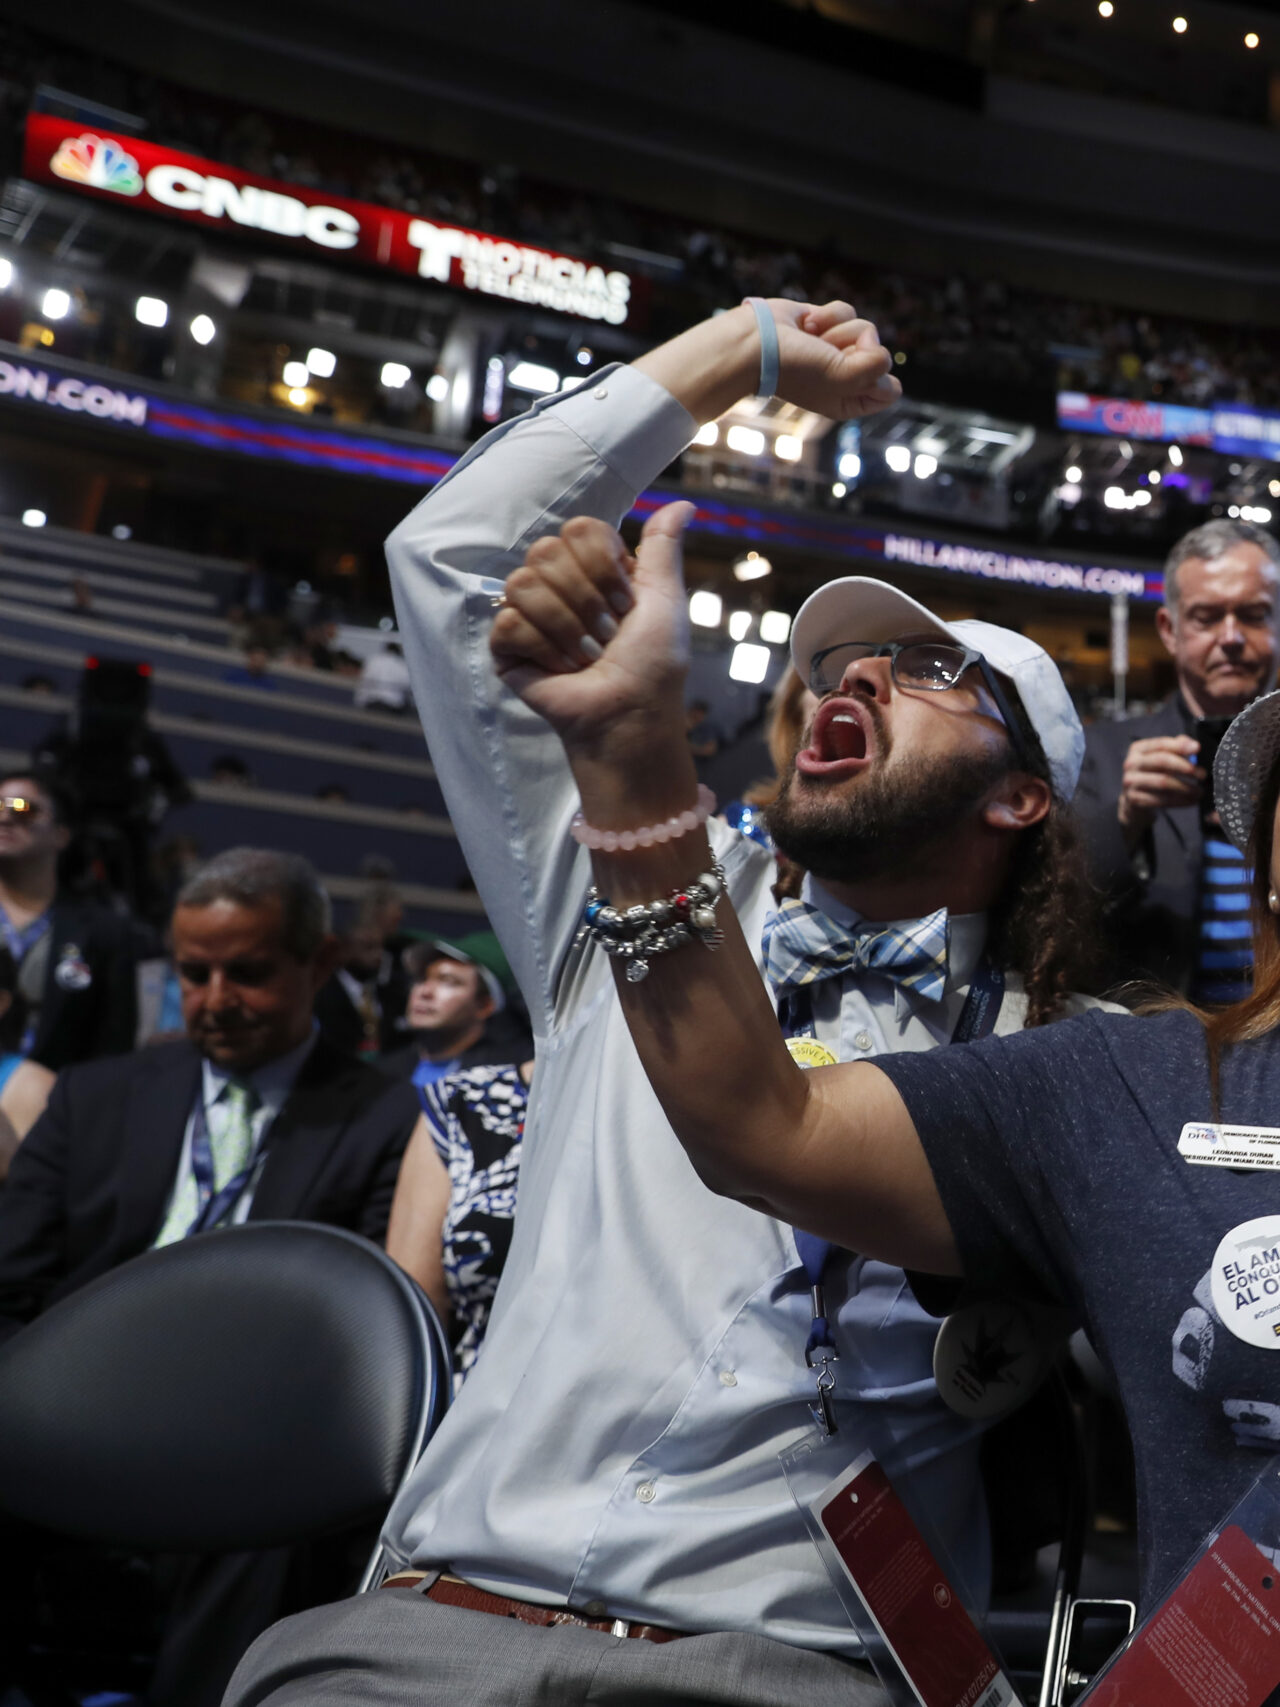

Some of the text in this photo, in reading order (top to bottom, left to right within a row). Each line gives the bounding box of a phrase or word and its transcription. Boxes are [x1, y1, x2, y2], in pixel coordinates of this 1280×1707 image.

[145, 164, 360, 250] CNBC
[460, 234, 631, 302] NOTICIAS
[1103, 401, 1164, 438] CNN
[884, 534, 1145, 597] HILLARYCLINTON.COM
[1212, 1149, 1248, 1157] LEONARDA
[1222, 1261, 1246, 1281] EL
[1236, 1291, 1260, 1310] AL
[1221, 1562, 1249, 1595] DEMOCRATIC
[1247, 1592, 1269, 1619] NATIONAL
